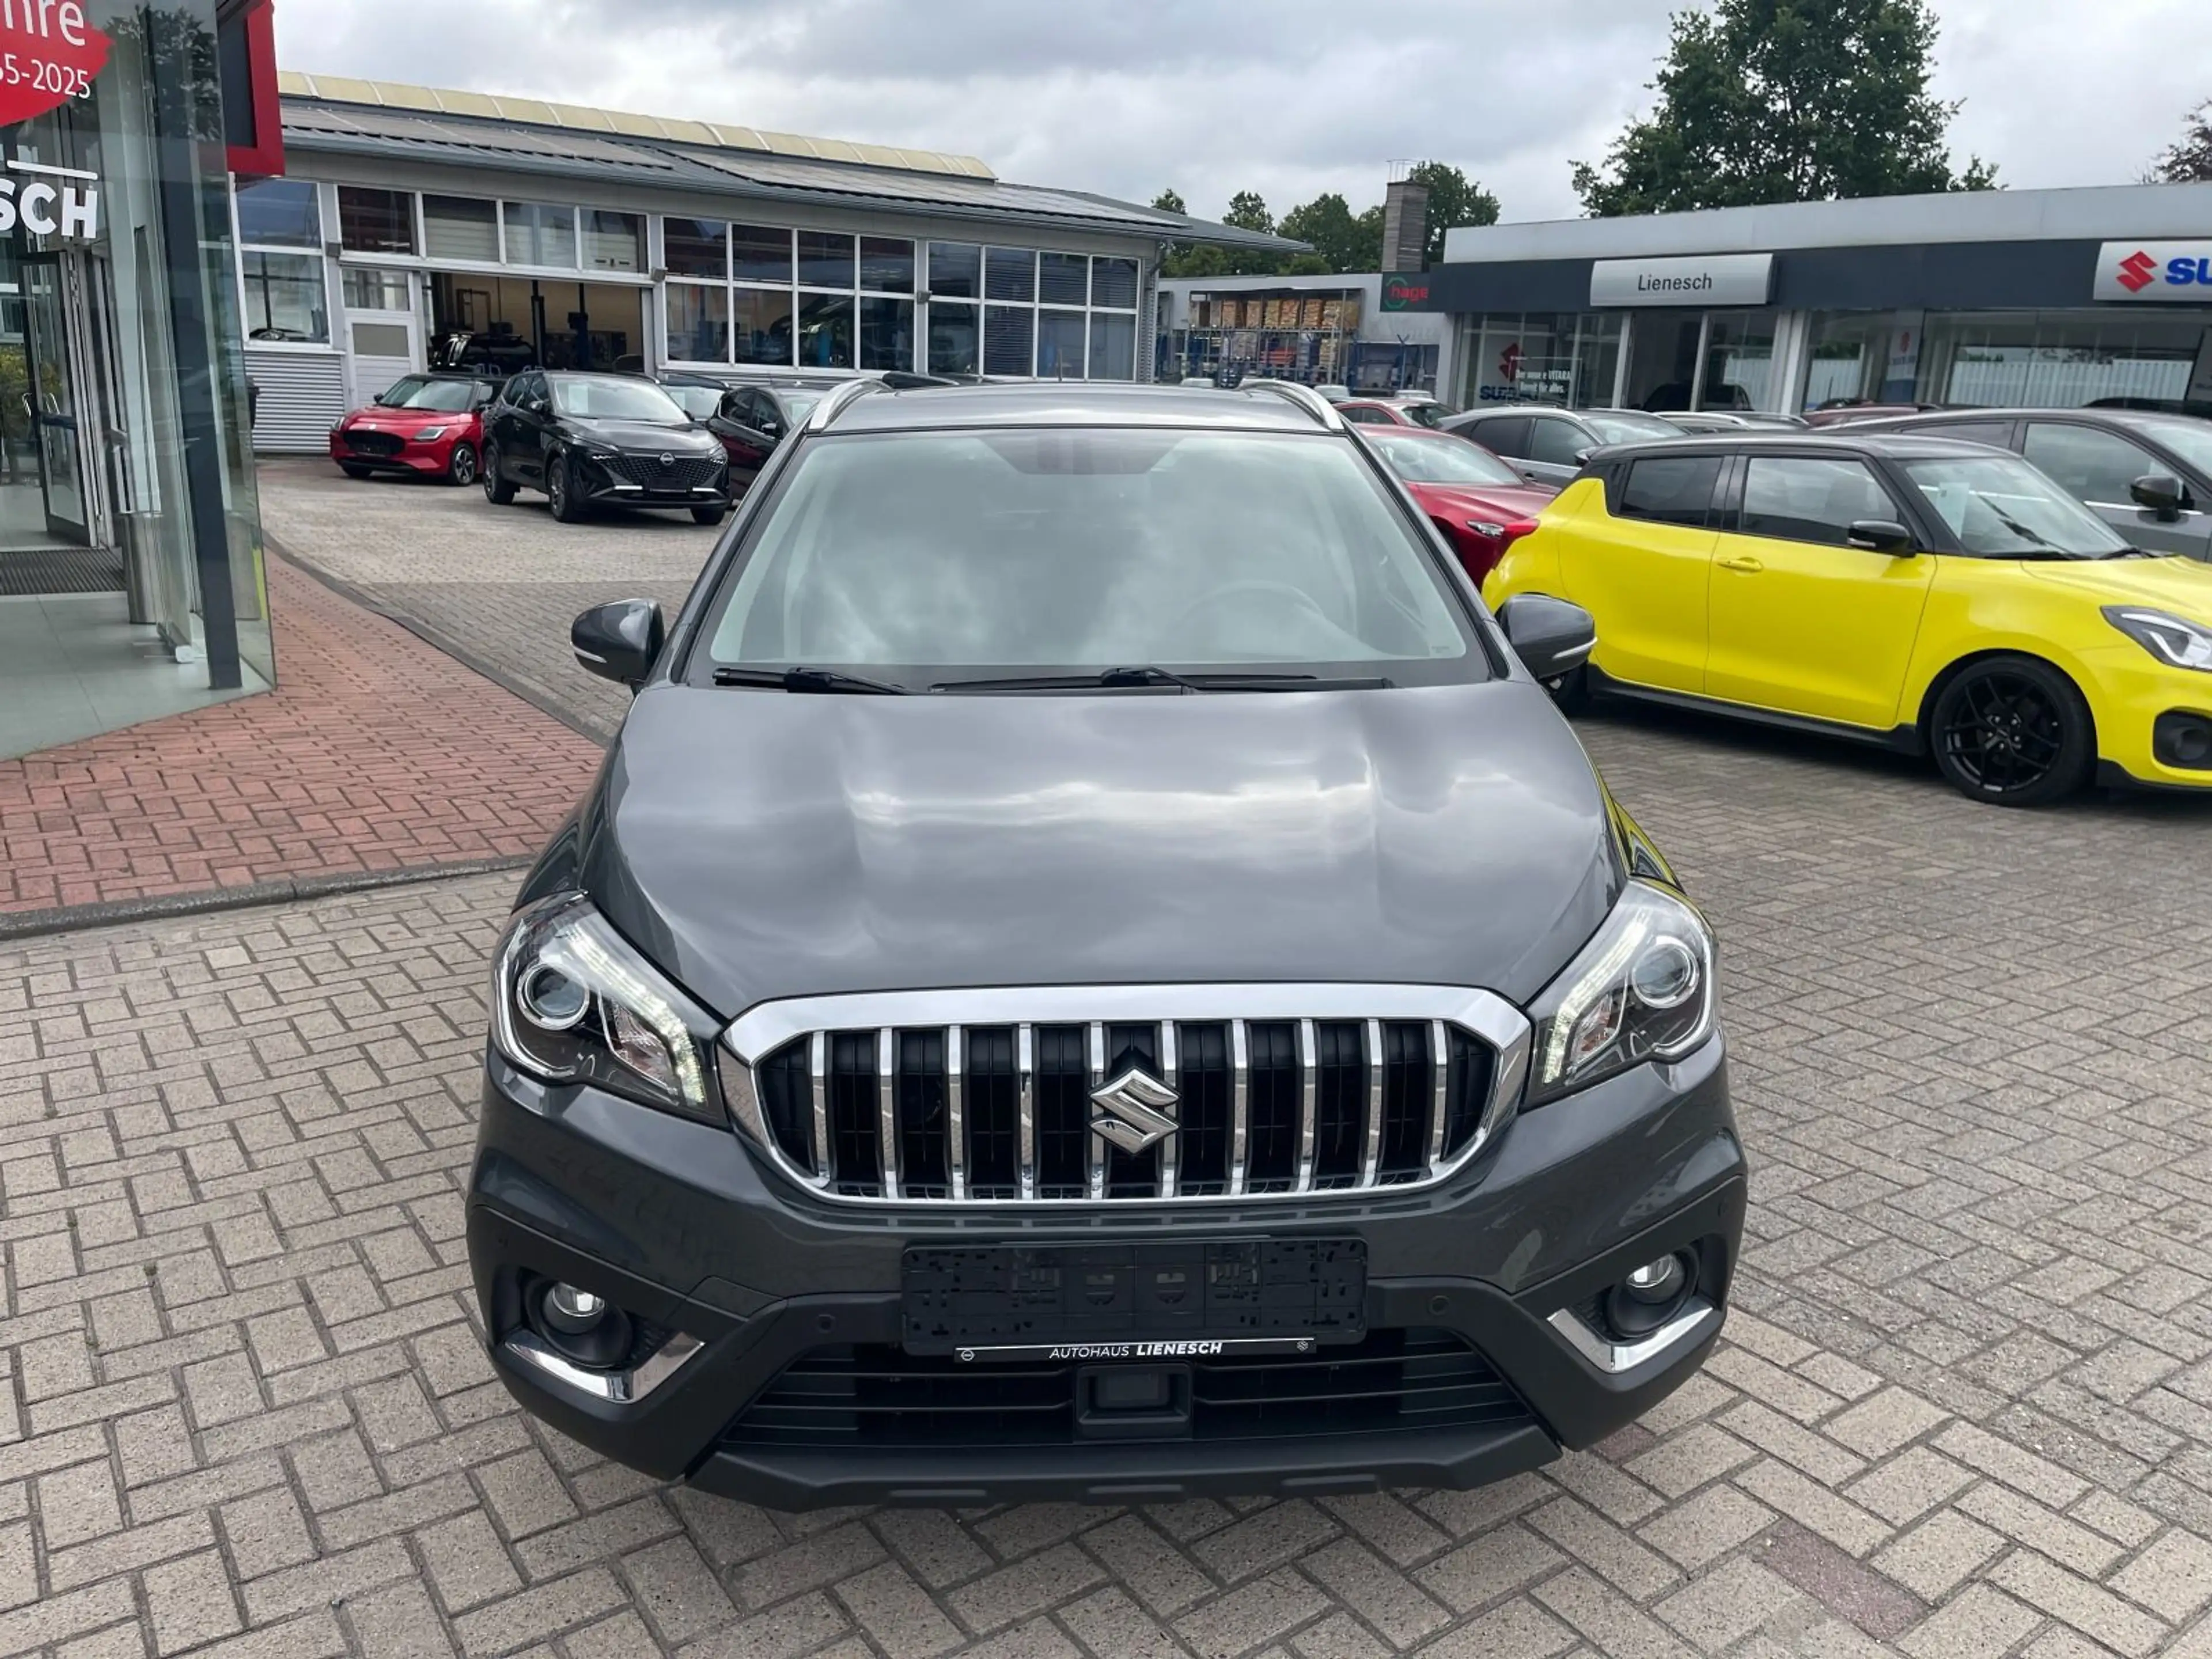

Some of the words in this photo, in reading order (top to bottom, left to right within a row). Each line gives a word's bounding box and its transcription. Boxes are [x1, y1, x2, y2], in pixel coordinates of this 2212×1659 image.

[0, 53, 90, 99] 5-2025
[1638, 272, 1713, 291] Lienesch
[1049, 1346, 1130, 1358] AUTOHAUS
[1137, 1342, 1222, 1356] LIENESCH
